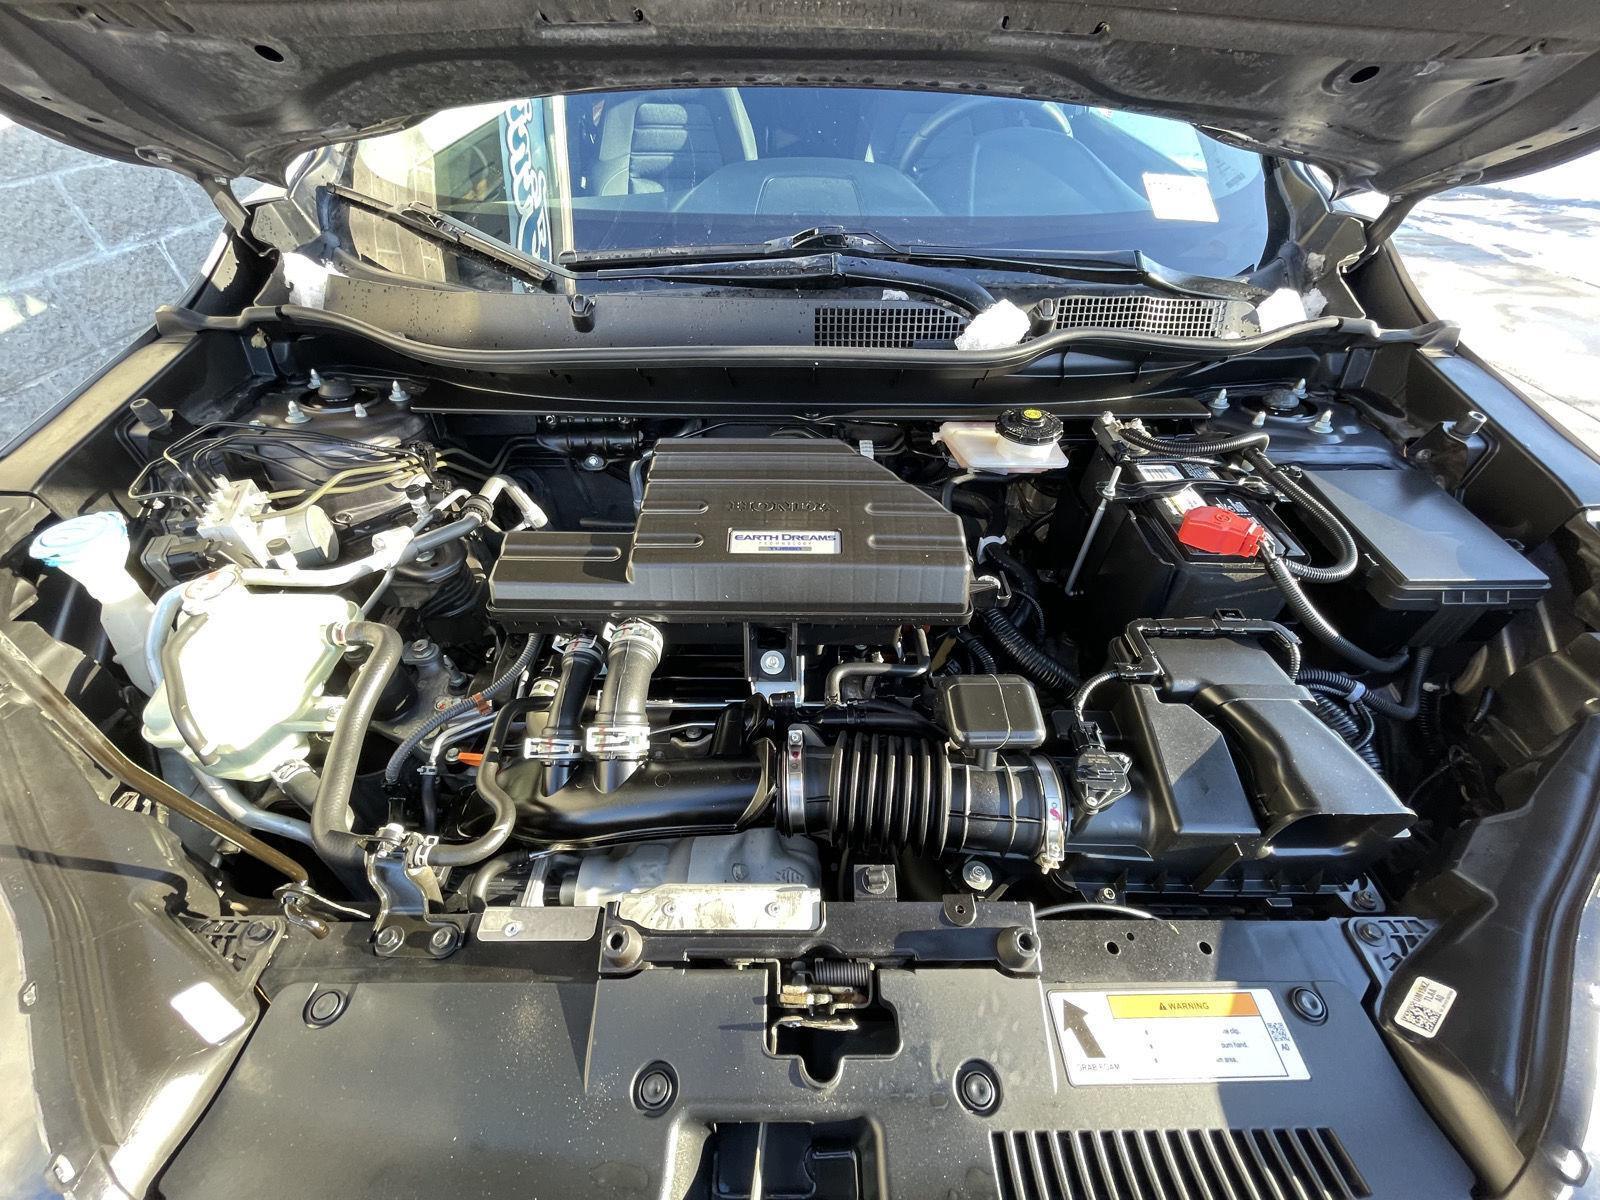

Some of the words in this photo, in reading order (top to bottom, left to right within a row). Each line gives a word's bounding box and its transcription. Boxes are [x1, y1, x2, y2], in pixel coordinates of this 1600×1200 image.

[729, 500, 839, 513] HONDA
[734, 533, 779, 541] EARTH
[781, 533, 837, 541] DREAMS
[1168, 1002, 1210, 1010] WARNING
